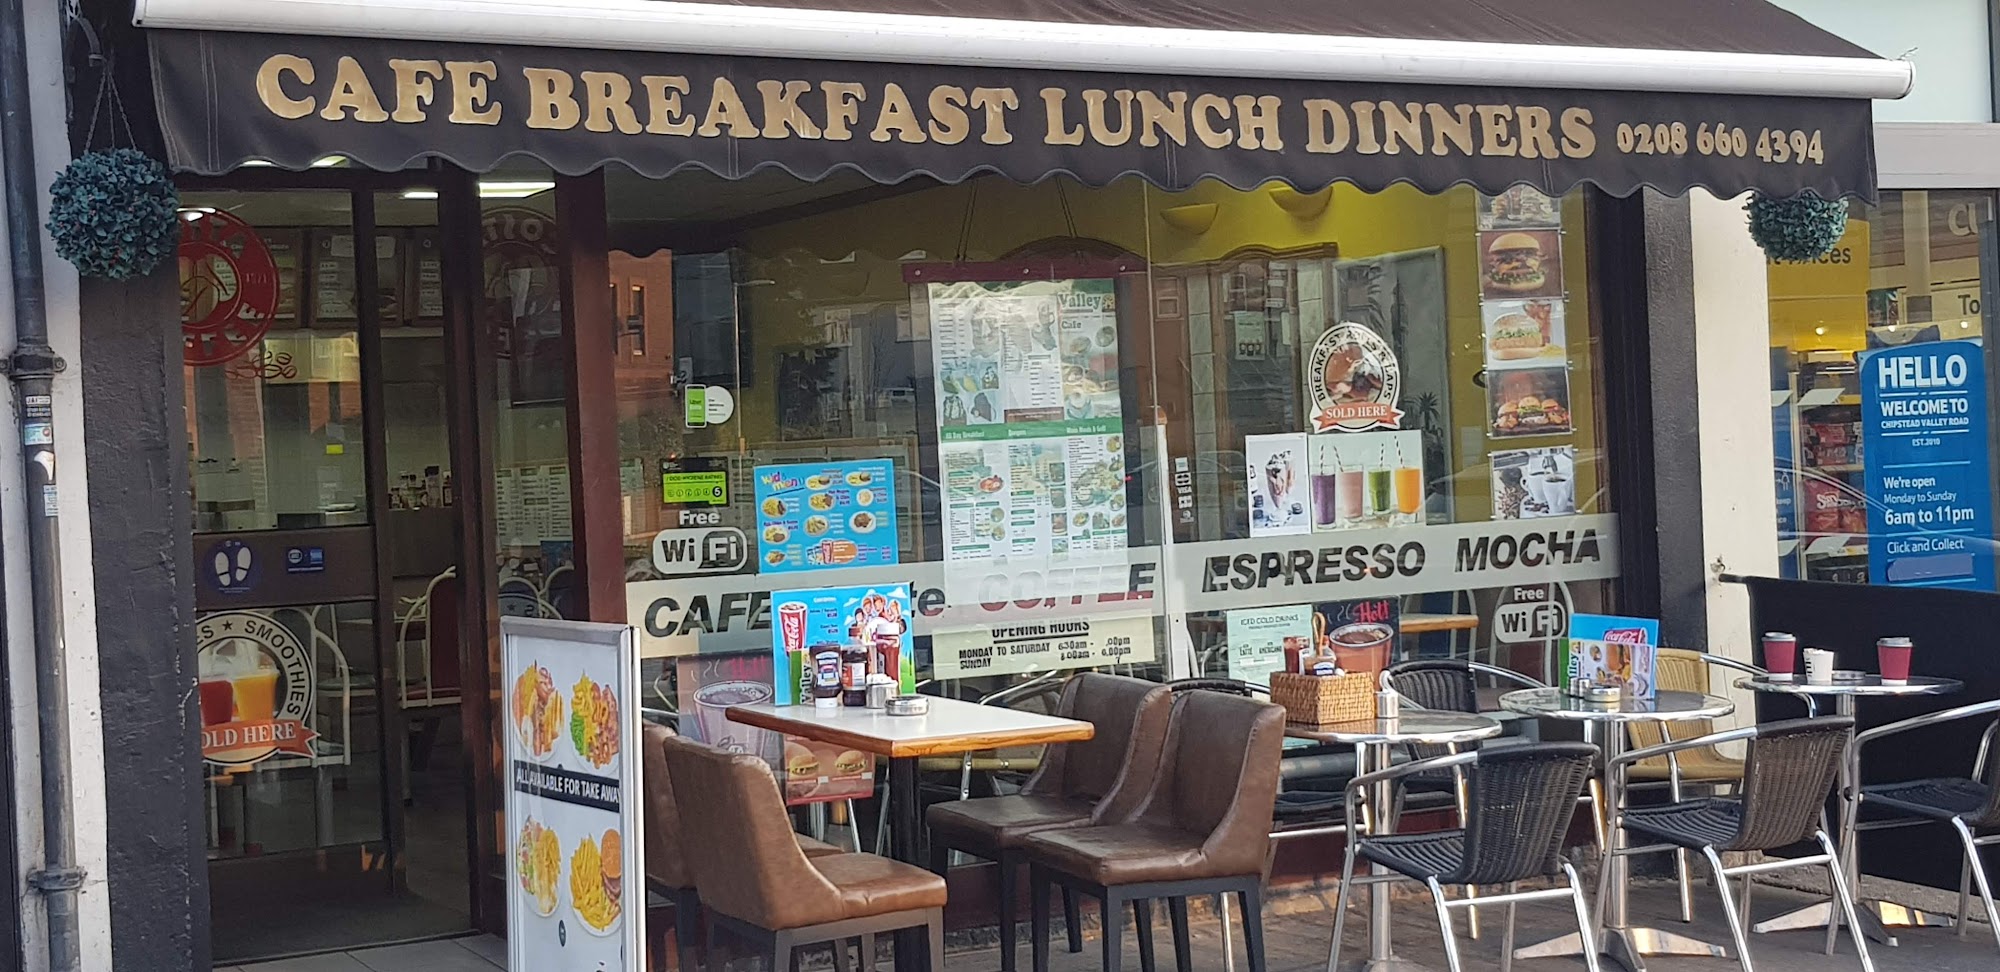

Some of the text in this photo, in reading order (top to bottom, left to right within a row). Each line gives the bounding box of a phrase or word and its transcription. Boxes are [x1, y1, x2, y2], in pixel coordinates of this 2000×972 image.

[256, 54, 1824, 165] CAFE BREAKFAST LUNCH DINNERS 0208 660 4394
[1058, 293, 1101, 310] Valley
[1061, 320, 1082, 330] Cafe
[1878, 354, 1968, 389] HELLO
[1326, 405, 1387, 419] SOLD HERE
[1880, 397, 1969, 417] WELCOME TO
[1881, 416, 1970, 430] CHIPSTEAD VALLEY ROAD
[1883, 476, 1936, 490] We're open
[1883, 490, 1957, 505] Monday to Sunday
[679, 510, 720, 526] Free
[1885, 505, 1974, 526] 6am to 11pm
[1454, 528, 1601, 573] MOCHA
[1886, 538, 1965, 555] Click and Collect
[1202, 541, 1426, 593] ESPRESSO
[1513, 587, 1544, 600] Free
[644, 592, 771, 638] CAFE
[992, 617, 1090, 639] OPENING HOURS
[959, 645, 993, 660] MONDAY
[997, 645, 1007, 656] TO
[1010, 642, 1051, 655] SATURDAY
[243, 619, 306, 716] SMOOTHIES
[960, 657, 992, 670] SUNDAY
[201, 721, 297, 749] OLD HERE
[516, 767, 529, 785] ALL
[528, 770, 563, 793] AVAILABLE
[564, 778, 581, 796] FOR
[582, 780, 600, 800] TAKE
